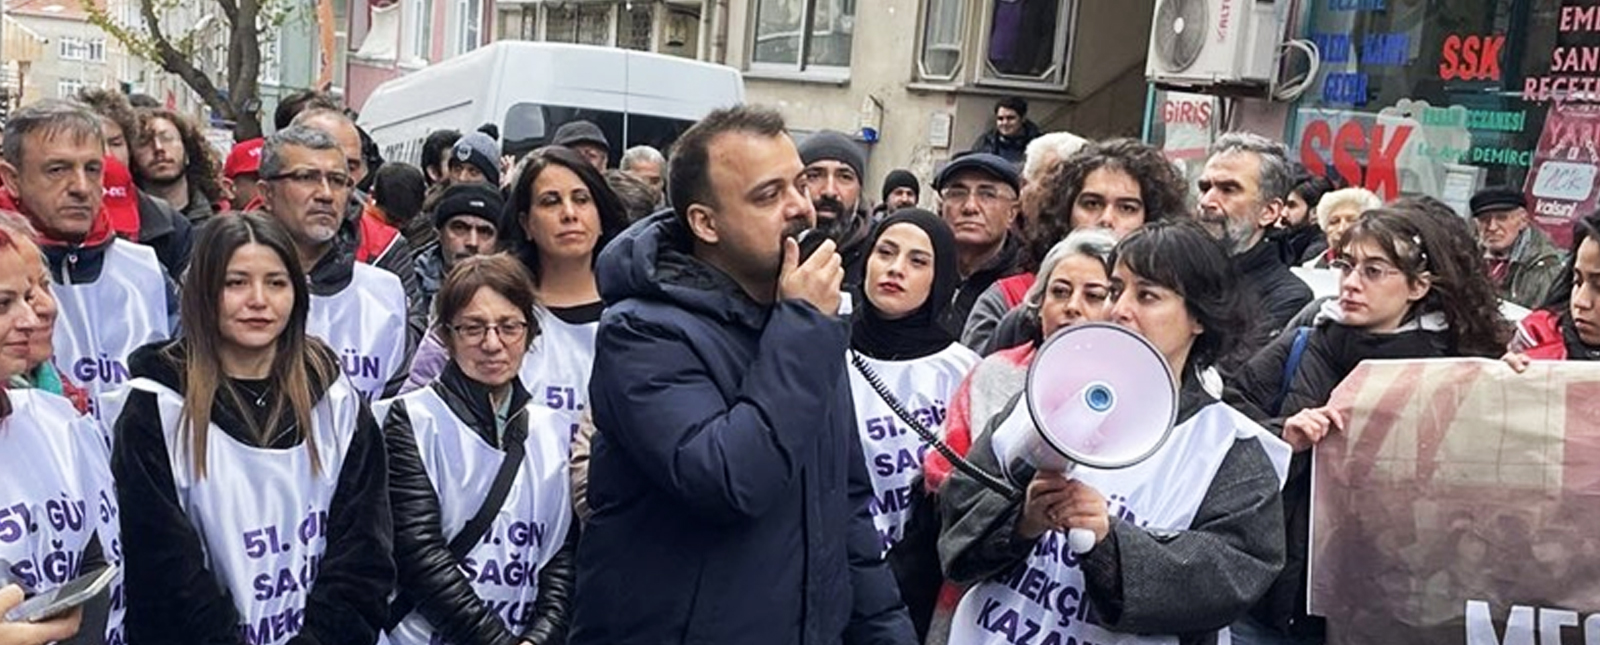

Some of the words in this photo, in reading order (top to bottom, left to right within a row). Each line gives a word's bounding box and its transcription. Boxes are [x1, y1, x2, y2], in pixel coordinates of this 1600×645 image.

[1438, 34, 1505, 81] SSK
[1300, 119, 1415, 204] SSK
[341, 348, 380, 380] ÜN
[546, 385, 585, 411] 51.
[865, 415, 907, 441] 51.
[0, 502, 38, 543] 51.
[243, 524, 291, 559] 51.
